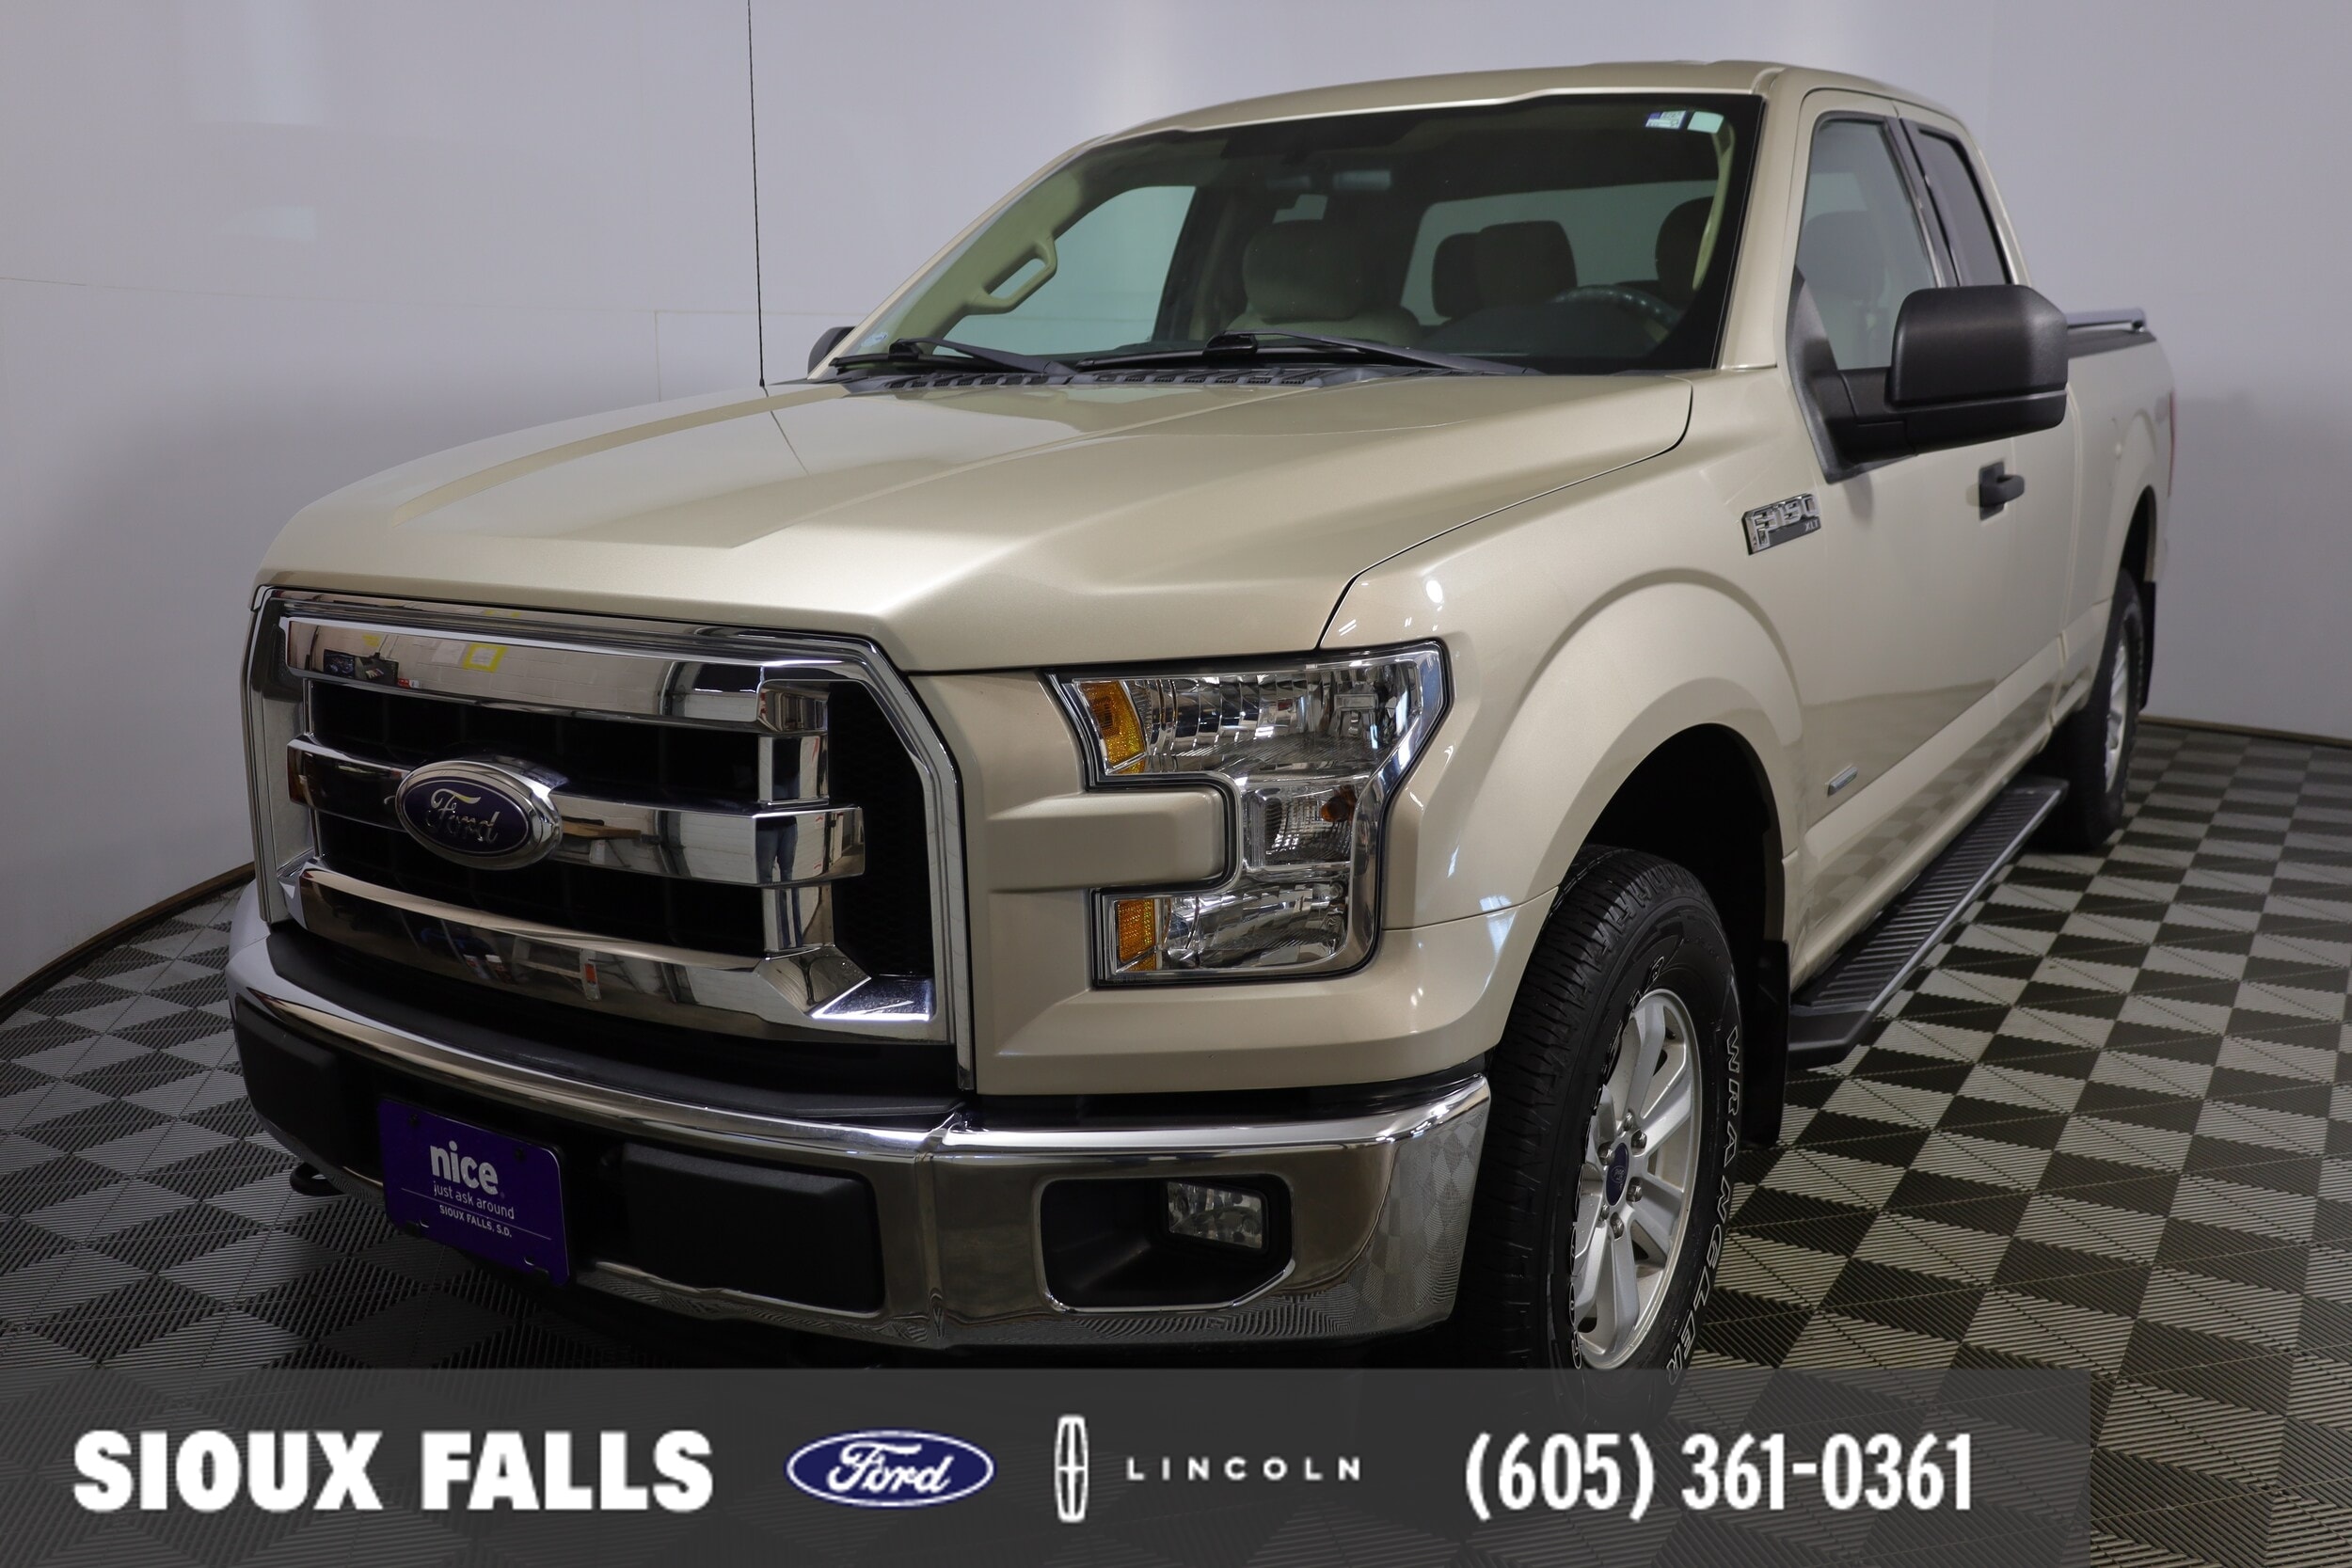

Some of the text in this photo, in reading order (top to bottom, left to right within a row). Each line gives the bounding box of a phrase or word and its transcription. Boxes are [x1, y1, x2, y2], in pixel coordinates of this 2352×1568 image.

[425, 788, 501, 843] Ford
[430, 1140, 499, 1196] nice
[434, 1181, 515, 1219] just ask around
[439, 1204, 465, 1221] SIOUX
[496, 1224, 513, 1238] S.D.
[1665, 1025, 1741, 1386] WRANGLER
